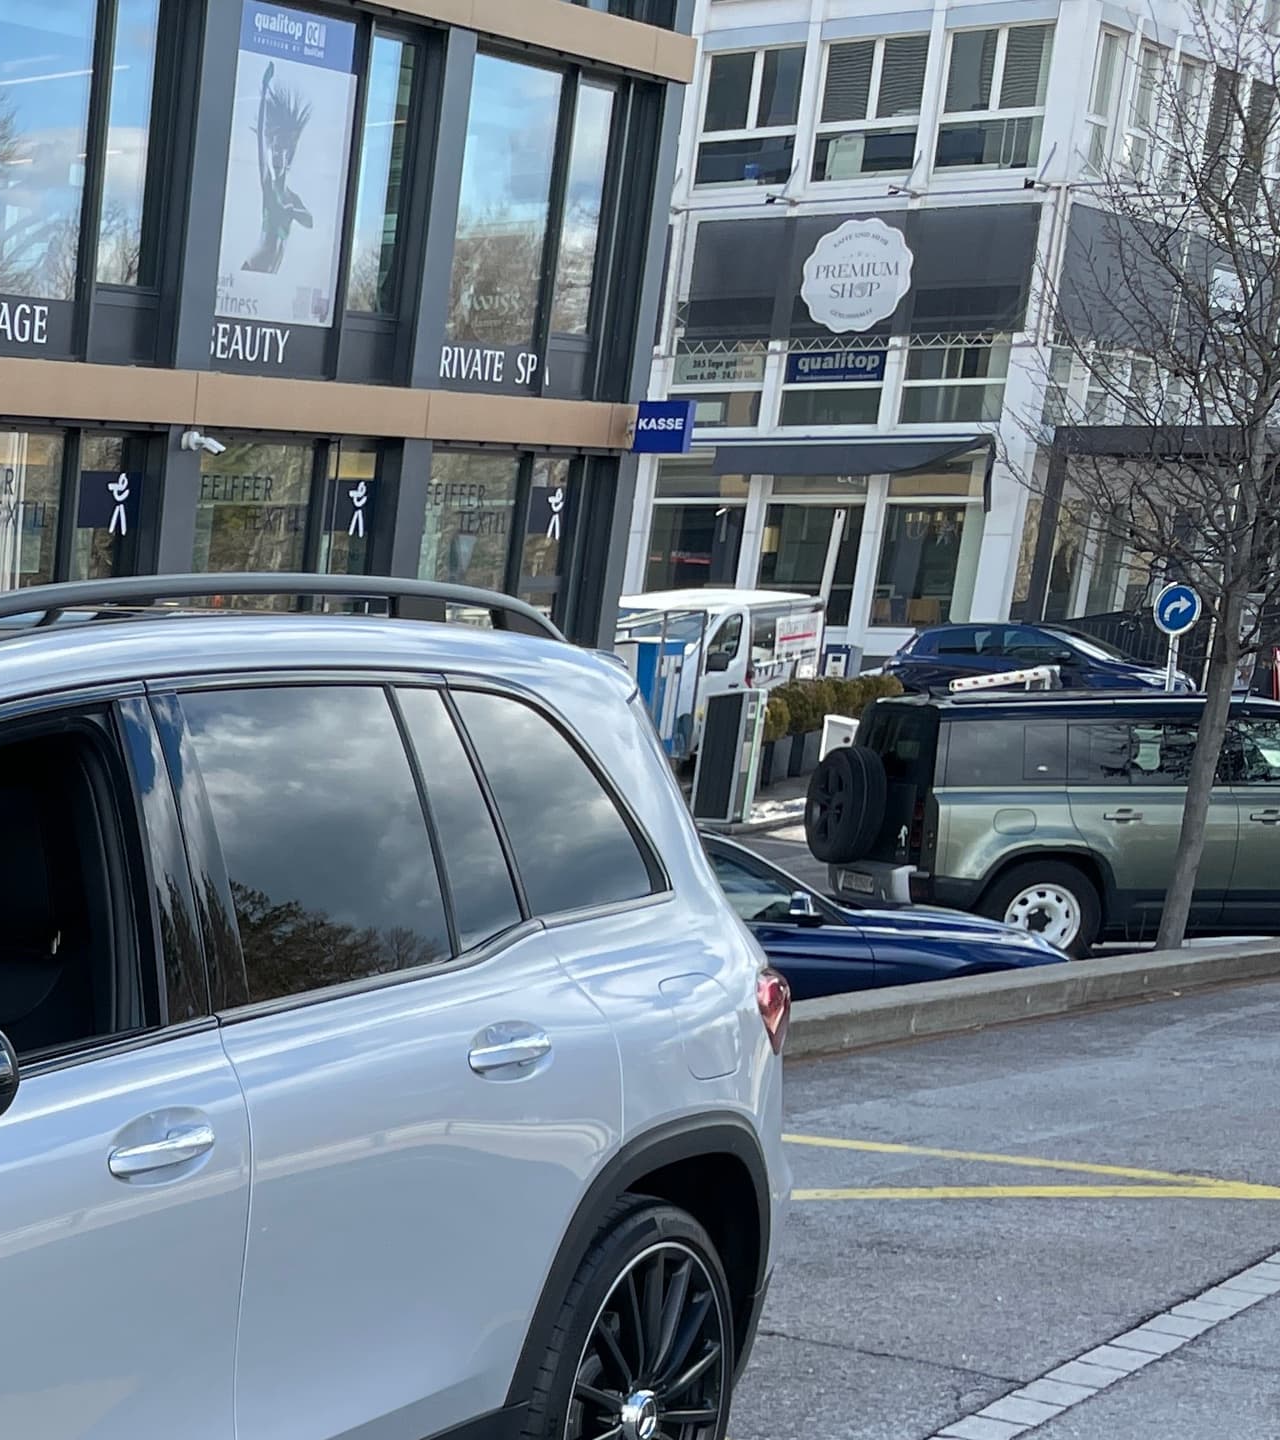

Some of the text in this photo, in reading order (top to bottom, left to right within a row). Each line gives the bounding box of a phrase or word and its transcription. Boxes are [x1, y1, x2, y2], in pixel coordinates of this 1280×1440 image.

[255, 13, 302, 40] qualitop
[815, 261, 900, 280] PREMIUM
[829, 282, 881, 300] SHOP
[210, 323, 290, 364] EAUTY
[798, 352, 880, 374] qualitop
[638, 417, 685, 431] KASSE
